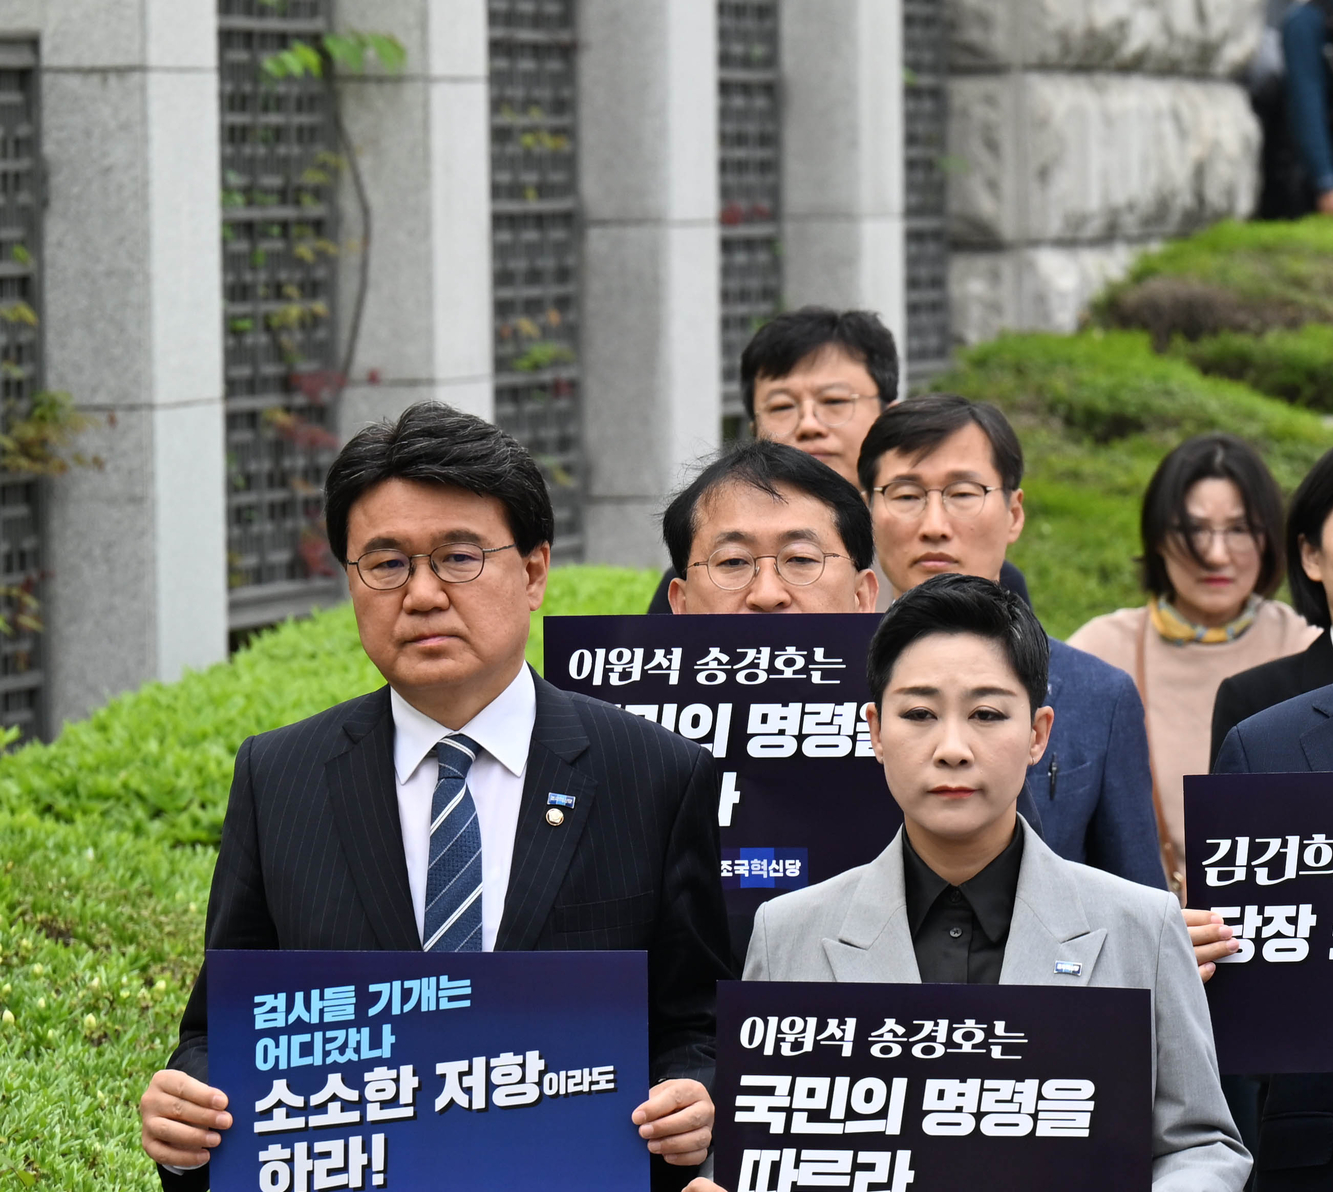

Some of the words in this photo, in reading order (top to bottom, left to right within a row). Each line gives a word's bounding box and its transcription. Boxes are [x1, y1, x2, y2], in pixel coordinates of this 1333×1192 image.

[569, 648, 682, 685] 이원석
[694, 647, 846, 685] 송경호는
[721, 859, 801, 878] 조국혁신당
[1209, 904, 1317, 964] 당장
[254, 985, 356, 1030] 검사들
[369, 976, 471, 1016] 기개는
[255, 1023, 397, 1072] 어디갔나
[740, 1017, 856, 1056] 이원석
[868, 1019, 1028, 1059] 송경호는
[254, 1064, 419, 1134] 소소한
[435, 1051, 614, 1111] 저항이라도
[735, 1075, 907, 1134] 국민의
[922, 1079, 1095, 1137] 명령을
